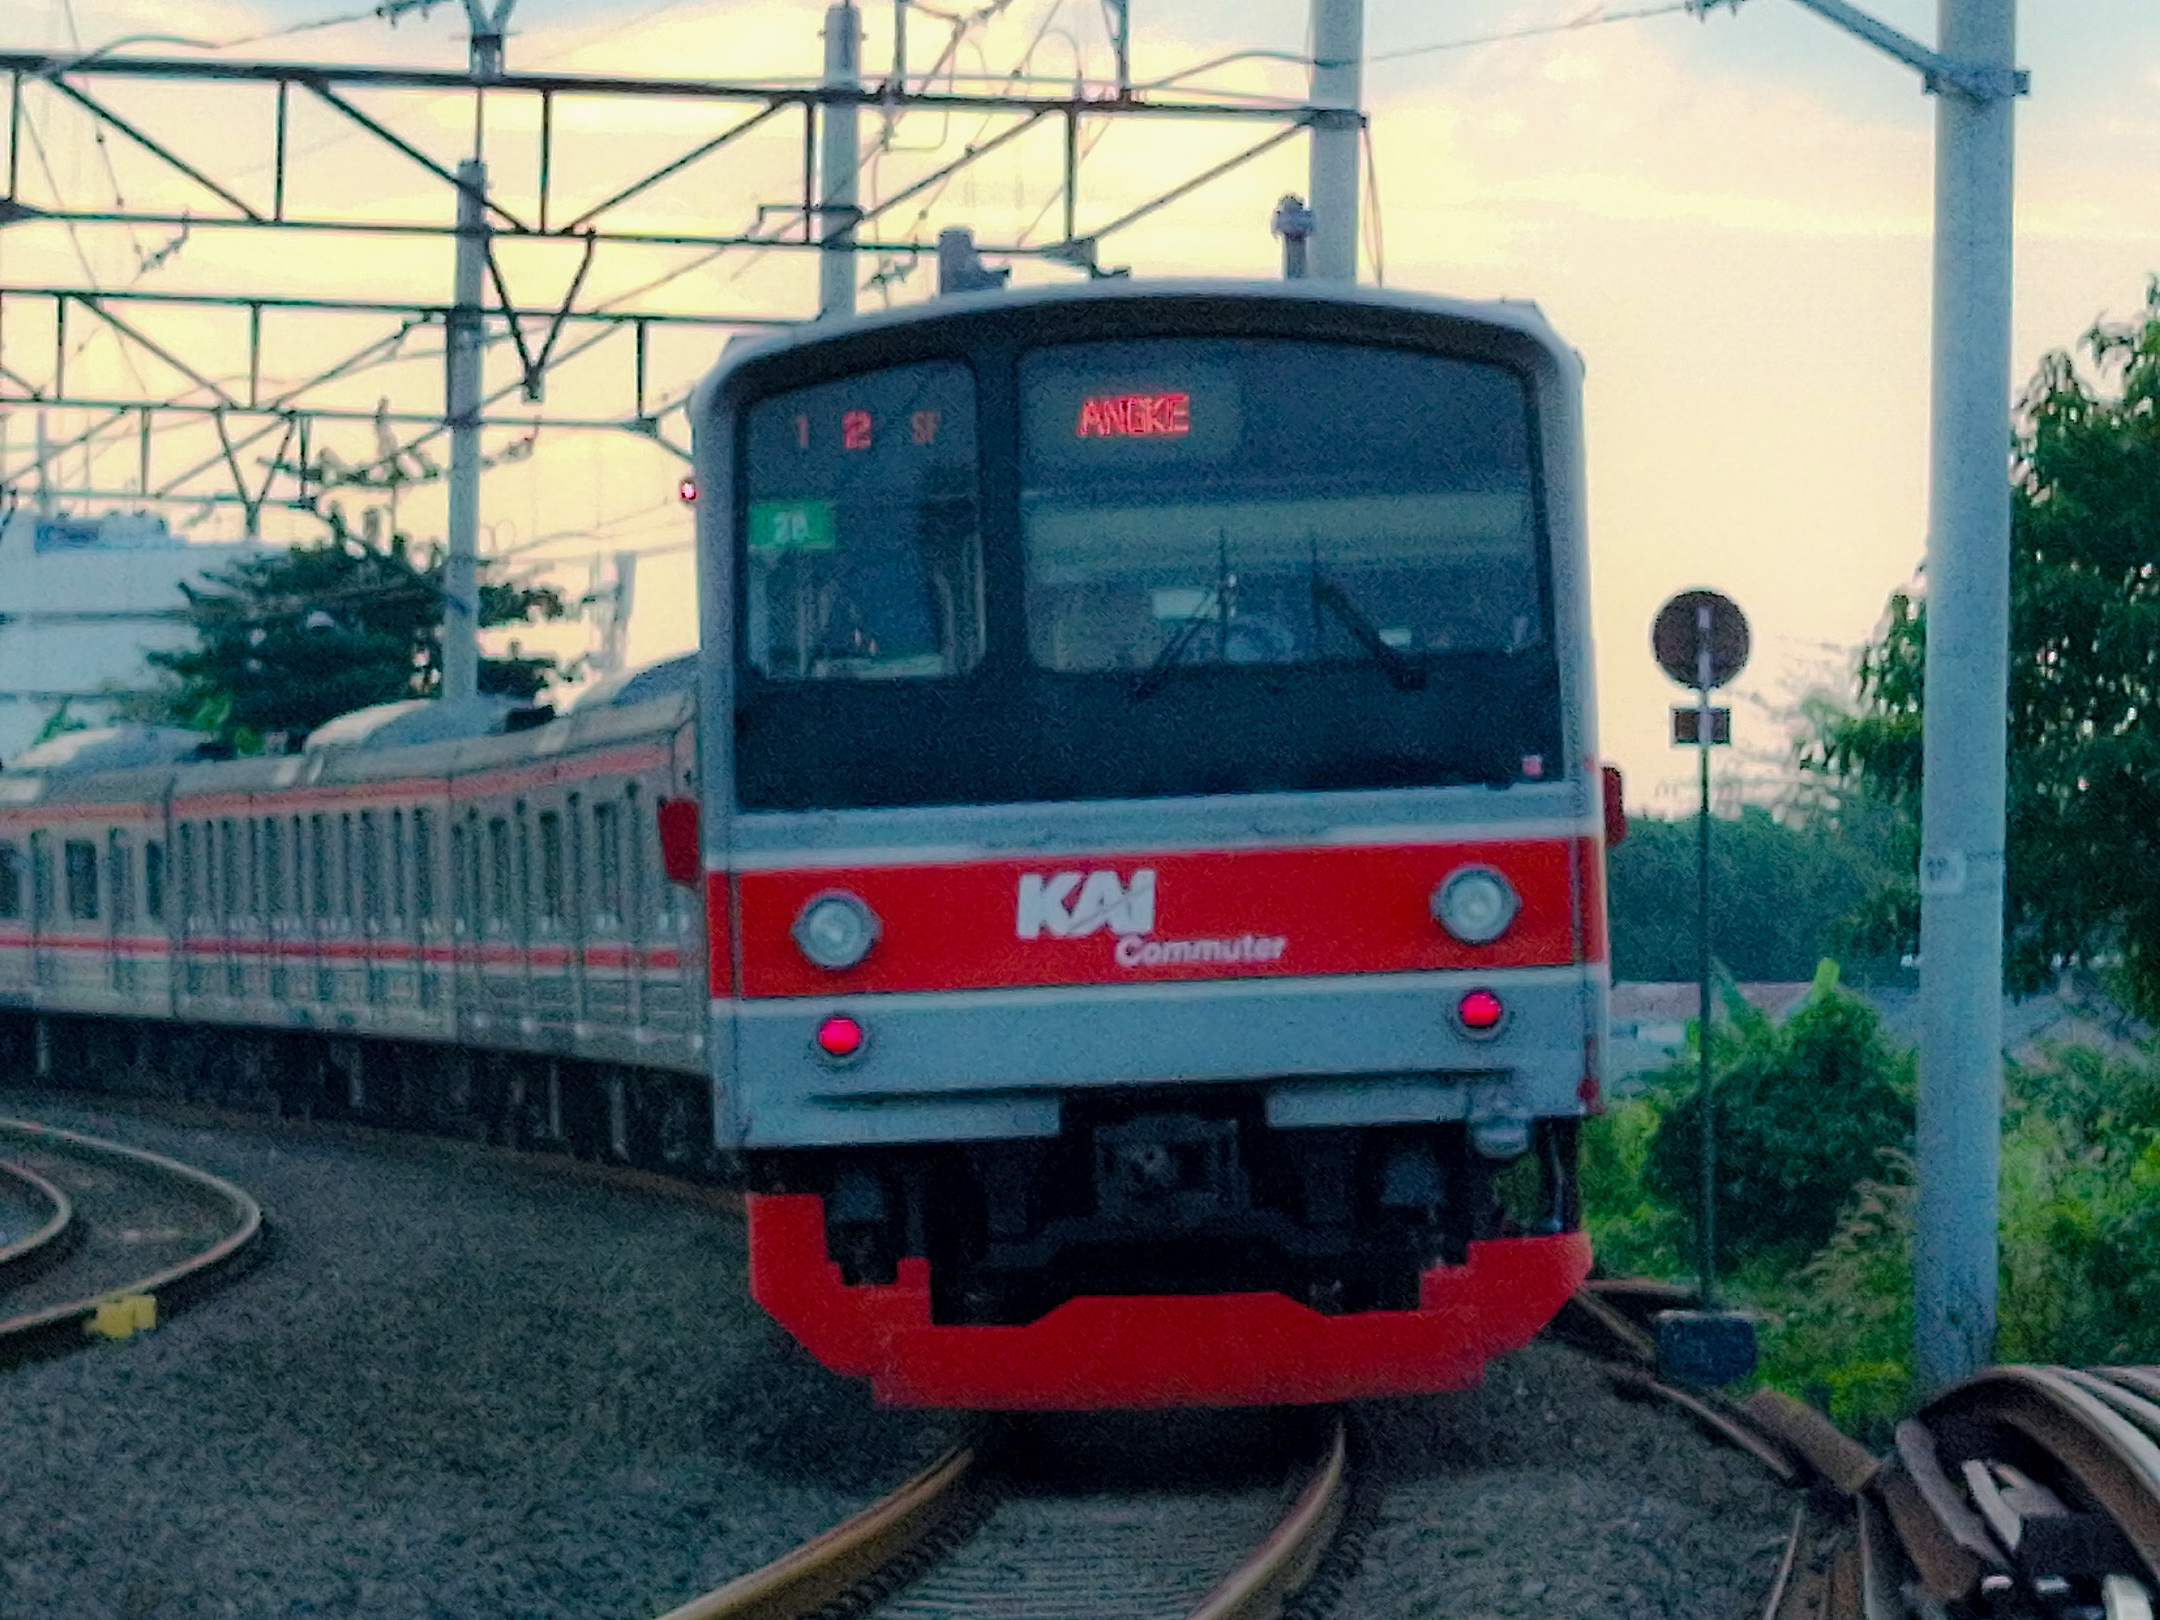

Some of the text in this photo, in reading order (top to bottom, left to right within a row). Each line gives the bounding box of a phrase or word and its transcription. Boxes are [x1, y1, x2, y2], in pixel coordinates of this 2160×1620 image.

[1078, 395, 1190, 436] ANGKE
[1016, 868, 1156, 941] KAI
[1114, 935, 1288, 968] Commuter
